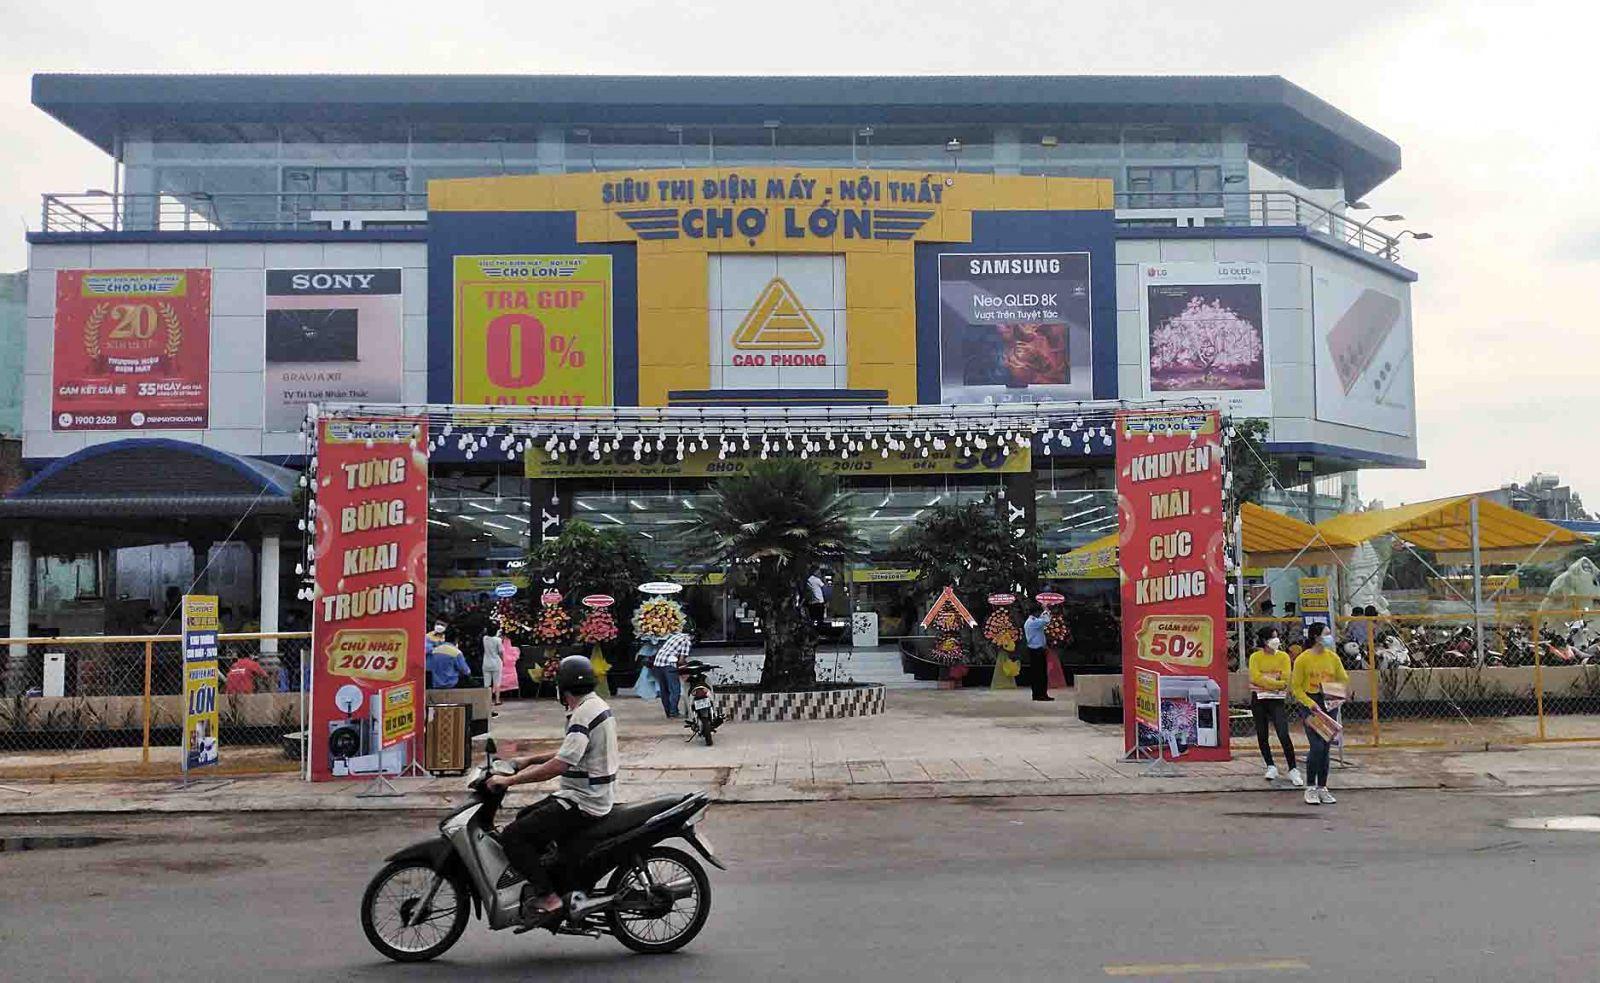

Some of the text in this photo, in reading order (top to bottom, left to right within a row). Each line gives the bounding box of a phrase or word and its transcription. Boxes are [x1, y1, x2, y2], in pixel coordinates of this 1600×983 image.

[602, 177, 649, 203] SIÊU
[657, 177, 695, 204] THỊ
[702, 173, 757, 204] ĐIỆN
[765, 172, 816, 199] MÁY
[839, 175, 881, 206] NỘI
[888, 173, 944, 204] THẤT
[682, 199, 871, 247] CHỢ LỚN
[969, 259, 1061, 275] SAMSUNG
[1157, 269, 1168, 277] LG
[291, 273, 375, 290] SONY
[973, 293, 1058, 308] Neo QLED 8K
[108, 304, 158, 340] 20
[732, 354, 827, 367] CAO PHONG
[138, 383, 156, 396] 35
[282, 372, 325, 382] BRAVIA
[75, 415, 117, 424] 1900 2628
[832, 461, 874, 471] 20/03
[1131, 440, 1210, 482] KHUYẾN
[341, 499, 405, 534] BỪNG
[1151, 488, 1190, 520] MÃI
[343, 542, 398, 576] KHAI
[1149, 529, 1192, 563] CỰC
[1136, 568, 1206, 606] KHỦNG
[322, 583, 415, 622] TRƯƠNG
[340, 638, 367, 651] CHỦ
[1150, 633, 1204, 659] 50%
[338, 654, 400, 672] 20/03
[188, 683, 216, 715] LỚN
